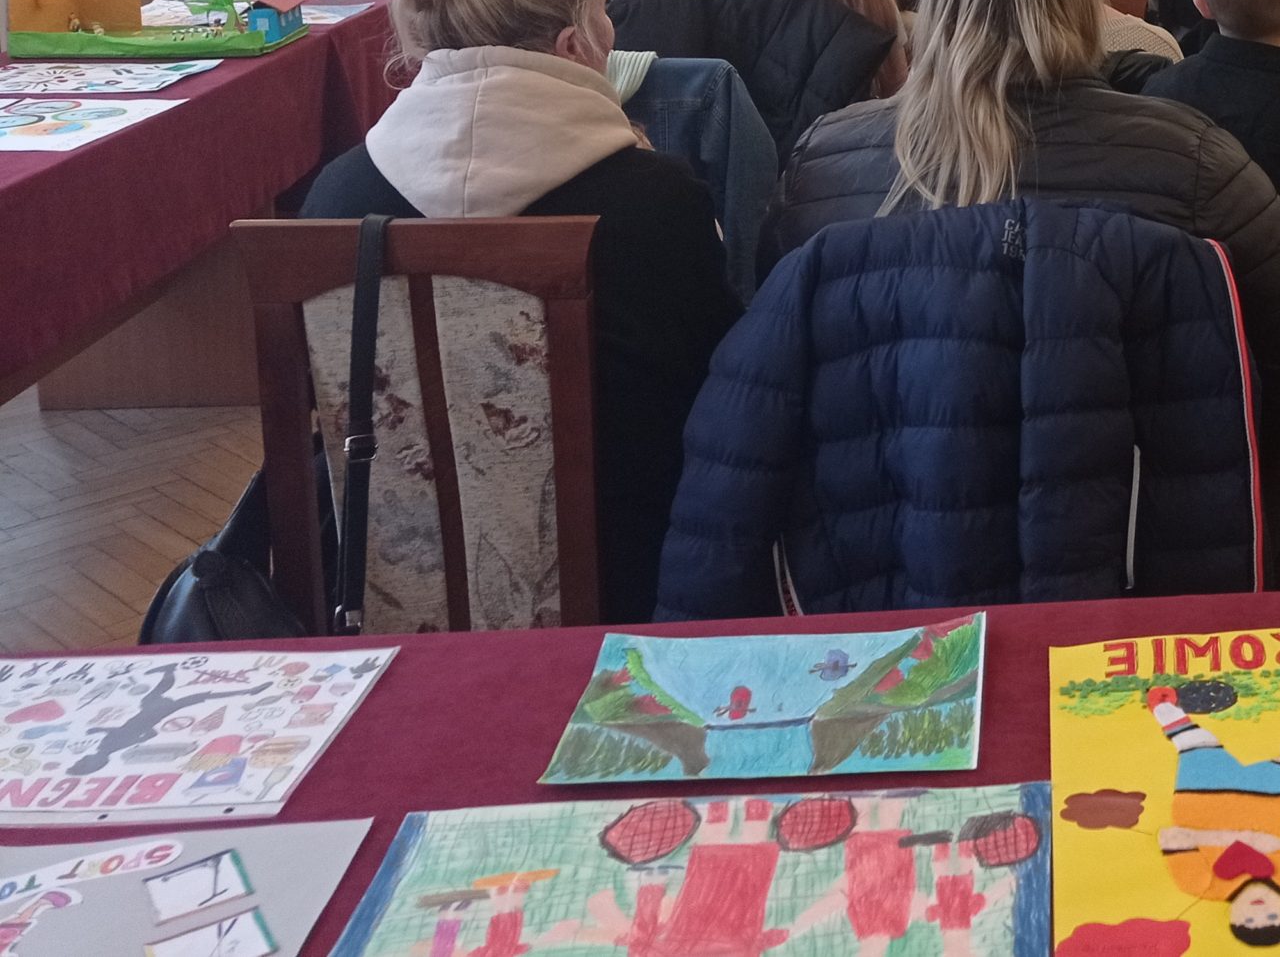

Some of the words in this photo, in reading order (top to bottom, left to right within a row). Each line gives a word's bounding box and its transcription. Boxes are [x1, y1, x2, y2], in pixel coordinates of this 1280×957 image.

[0, 773, 183, 808] BIEGN
[56, 844, 175, 880] SPORT
[0, 874, 43, 900] TO
